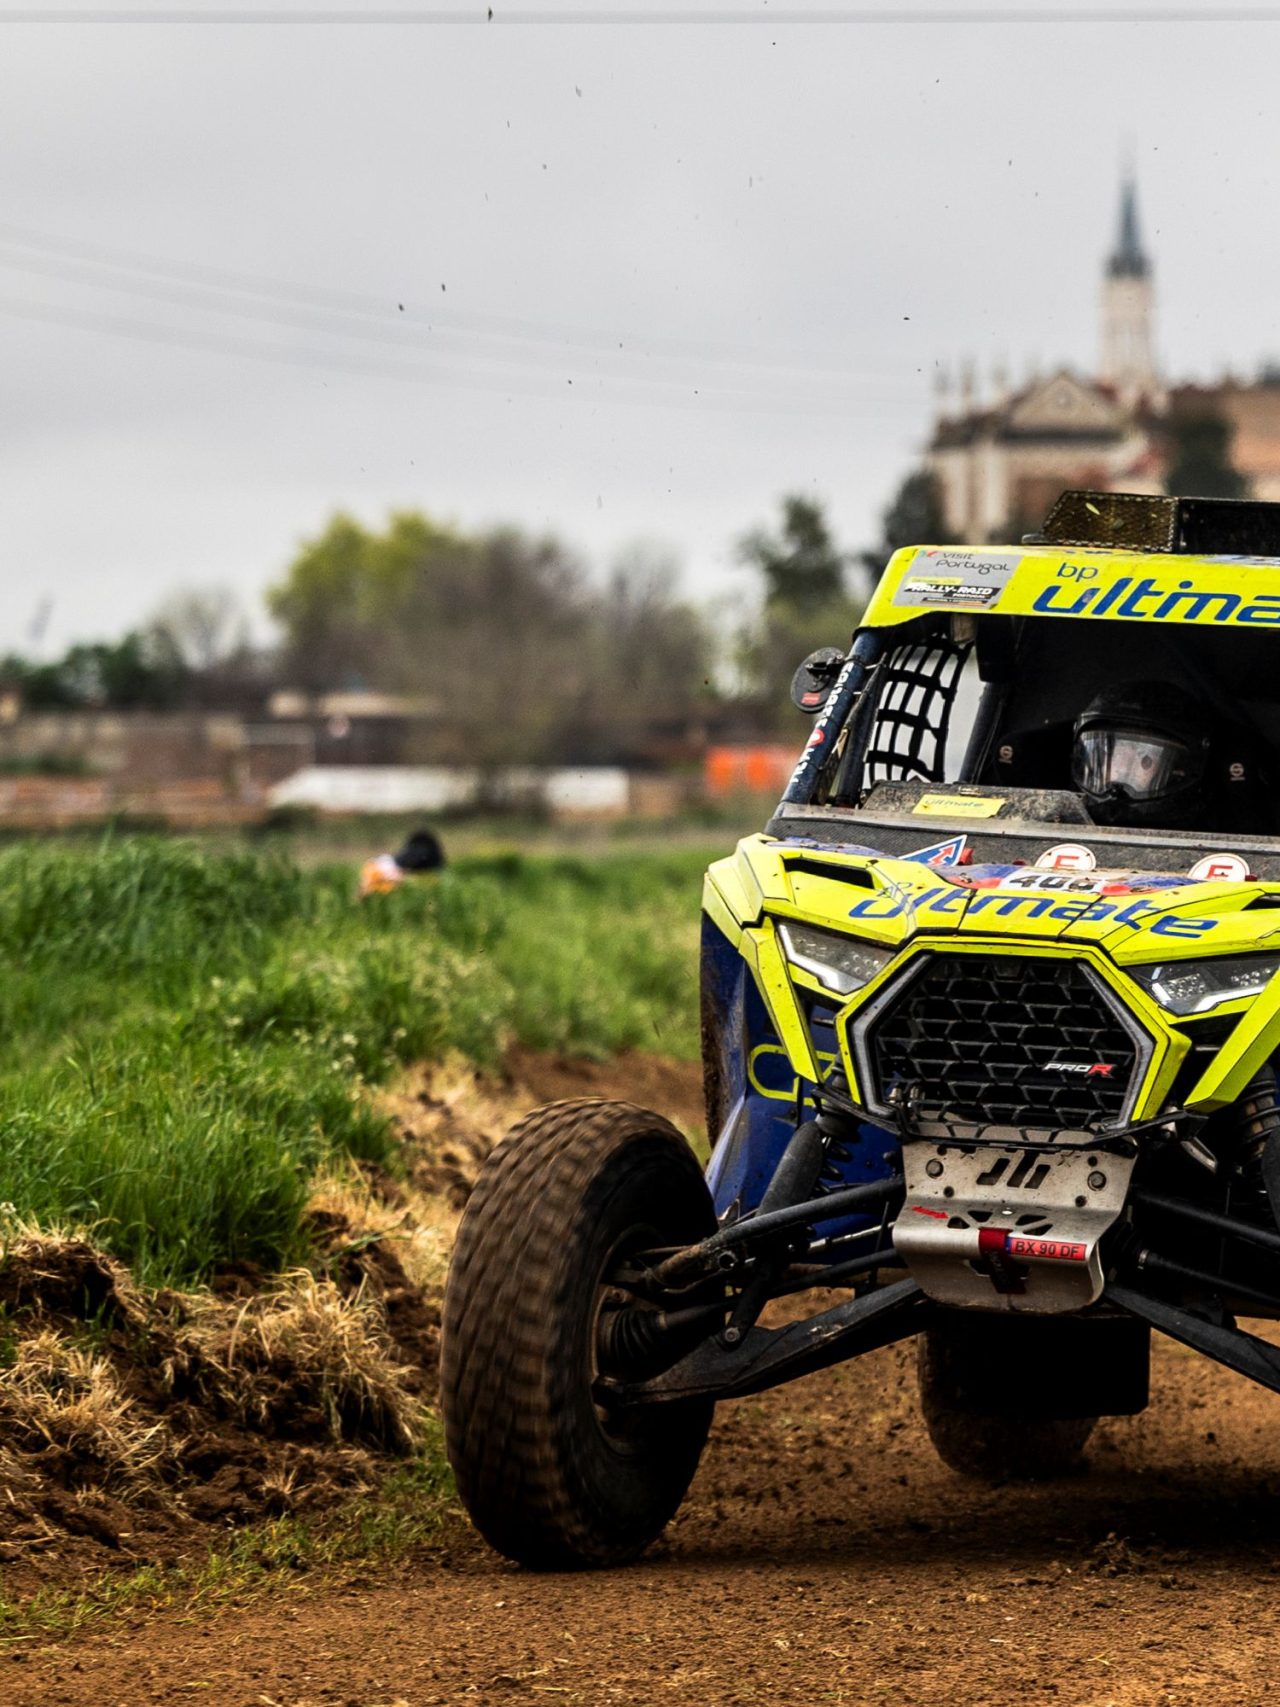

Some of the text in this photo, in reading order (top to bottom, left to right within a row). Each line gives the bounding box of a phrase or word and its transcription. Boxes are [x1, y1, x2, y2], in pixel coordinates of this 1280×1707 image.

[936, 560, 1011, 575] Portugal
[1056, 562, 1099, 582] bp
[848, 886, 1219, 939] ultimate
[1015, 1241, 1035, 1254] BX
[1039, 1243, 1056, 1256] 90
